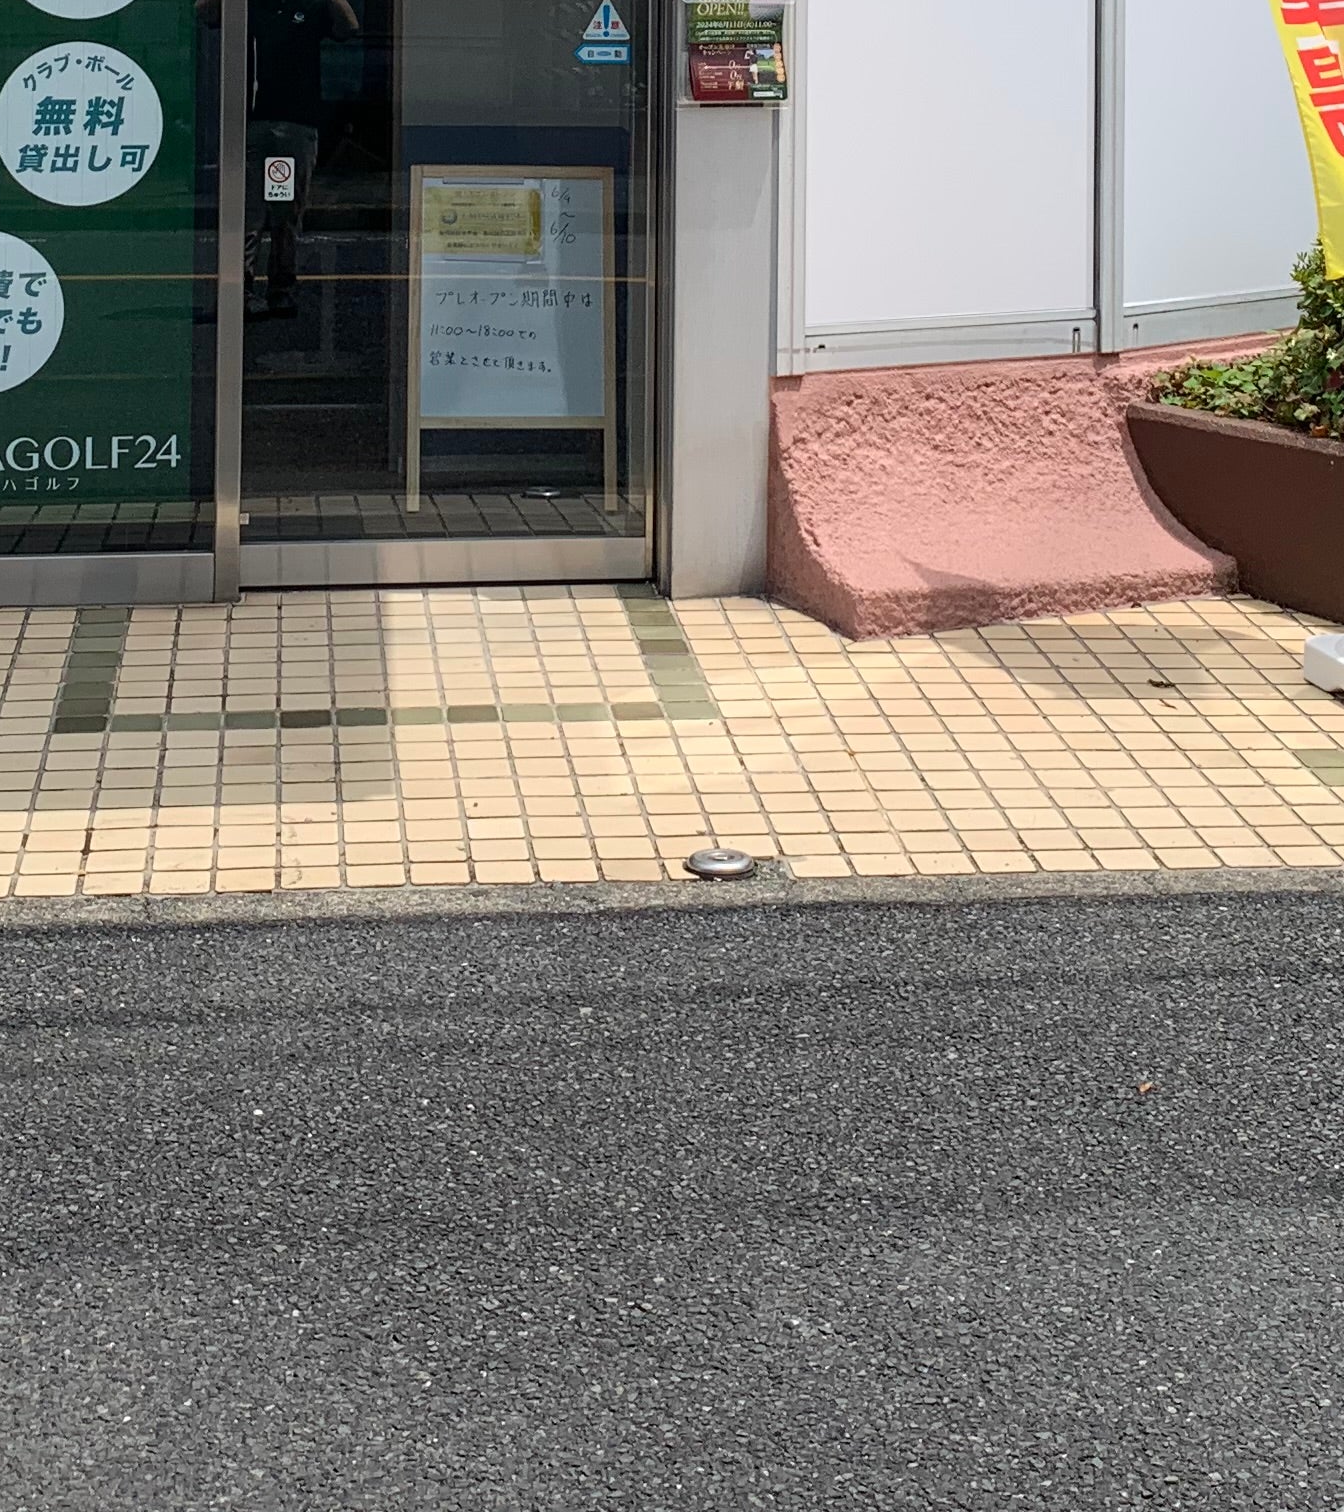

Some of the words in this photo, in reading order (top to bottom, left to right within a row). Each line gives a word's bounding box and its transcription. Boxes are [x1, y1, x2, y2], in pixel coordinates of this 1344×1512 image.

[33, 96, 127, 137] 無料
[15, 143, 150, 174] 貸出し可
